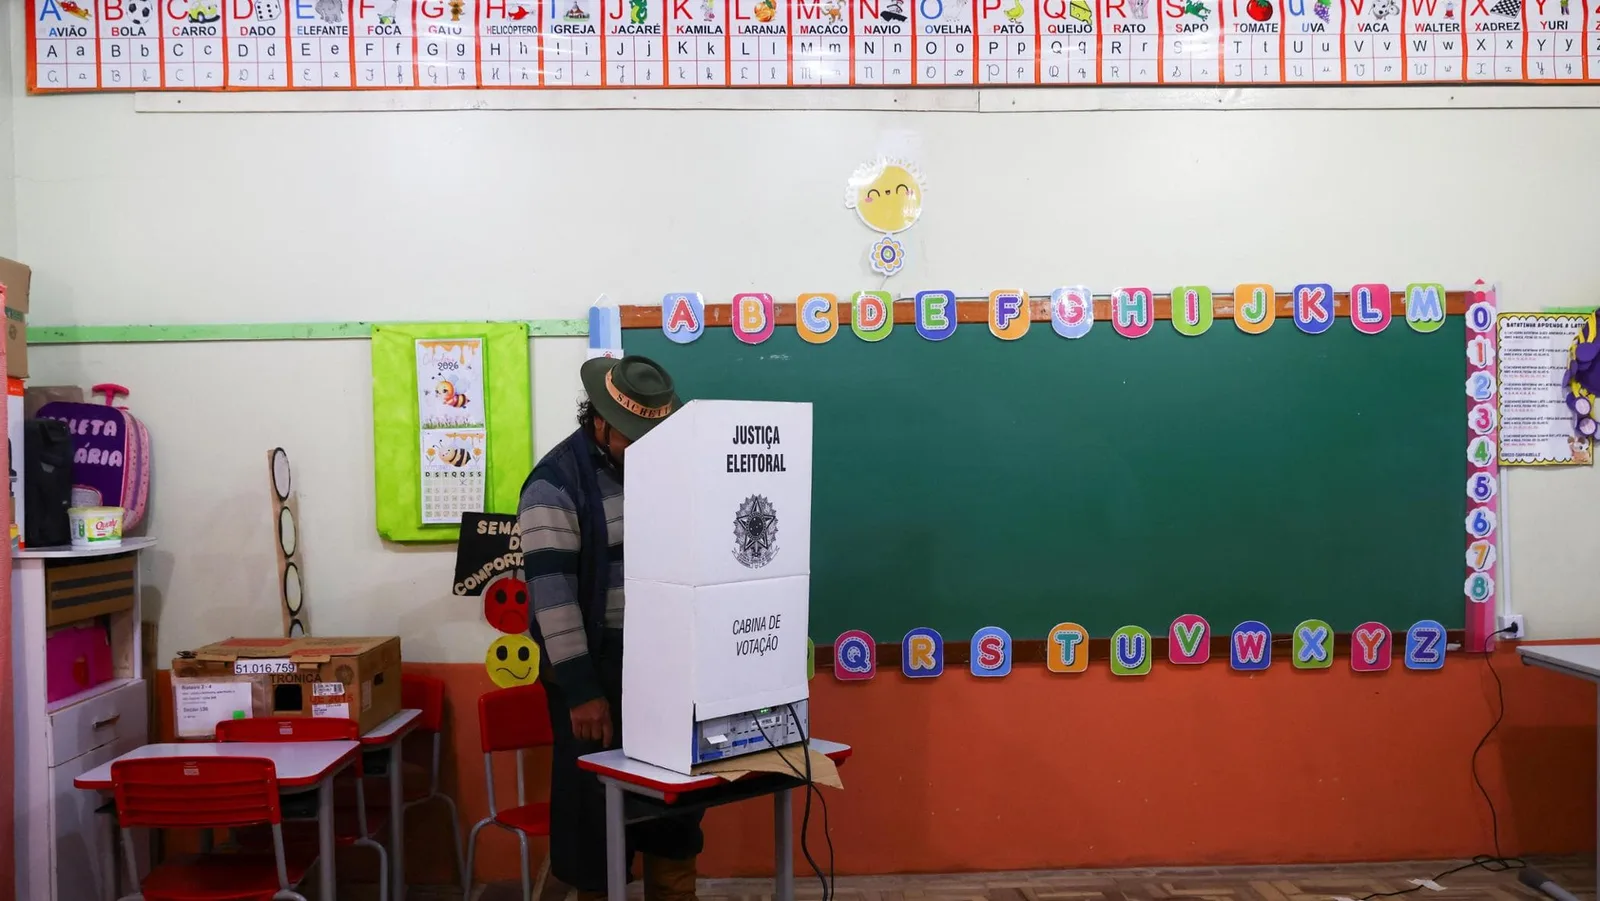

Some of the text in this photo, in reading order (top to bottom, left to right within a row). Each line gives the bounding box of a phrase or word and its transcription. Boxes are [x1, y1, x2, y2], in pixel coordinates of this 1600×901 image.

[40, 0, 62, 21] A
[105, 0, 123, 20] B
[167, 0, 190, 21] C
[234, 0, 255, 19] D
[296, 0, 314, 19] E
[360, 0, 374, 18] F
[421, 1, 444, 18] G
[487, 0, 506, 18] H
[610, 0, 623, 19] J
[674, 0, 692, 19] K
[798, 0, 820, 19] M
[860, 0, 878, 19] N
[920, 0, 943, 19] O
[983, 0, 1001, 19] P
[1044, 0, 1066, 19] Q
[1106, 0, 1126, 18] R
[1166, 0, 1185, 18] S
[49, 25, 87, 36] AVIÃO
[112, 26, 146, 36] BOLA
[172, 26, 216, 36] CARRO
[240, 26, 276, 36] DADO
[298, 26, 348, 35] ELEFANTE
[368, 25, 401, 35] FOCA
[487, 24, 538, 34] HELICÓPTERO
[551, 25, 595, 34] IGREJA
[612, 23, 660, 34] JACARÉ
[677, 25, 723, 34] KAMILA
[739, 25, 786, 35] LARANJA
[800, 25, 848, 34] MACACO
[864, 25, 900, 34] NAVIO
[925, 25, 971, 33] OVELHA
[994, 24, 1024, 33] PATO
[1048, 23, 1092, 35] QUEIJO
[1114, 24, 1145, 33] RATO
[1176, 24, 1208, 32] SAPO
[1234, 23, 1278, 32] TOMATE
[1302, 23, 1324, 32] UVA
[1358, 23, 1389, 32] VACA
[1415, 23, 1459, 33] WALTER
[1475, 22, 1520, 31] XADREZ
[1541, 21, 1568, 30] YURI
[47, 45, 84, 57] A a
[112, 44, 149, 57] B b
[238, 44, 275, 57] D d
[302, 43, 339, 56] E e
[366, 43, 373, 56] F
[427, 43, 464, 56] G g
[491, 42, 527, 55] H h
[616, 43, 624, 55] J
[679, 41, 715, 54] K k
[742, 43, 749, 55] L
[801, 42, 840, 54] M m
[865, 42, 901, 54] N n
[989, 42, 1025, 55] P p
[1051, 41, 1086, 54] Q q
[1112, 41, 1121, 54] R
[1234, 41, 1242, 53] T
[1537, 39, 1573, 51] Y y
[668, 286, 1443, 332] A B C D E F G H I J K L M
[1474, 307, 1489, 328] 0
[1476, 342, 1485, 366] 1
[438, 360, 458, 371] 2026
[1475, 374, 1490, 397] 2
[1476, 408, 1491, 431] 3
[732, 425, 780, 449] JUSTIÇA
[1475, 441, 1490, 464] 4
[726, 454, 786, 474] ELEITORAL
[1474, 476, 1490, 499] 5
[96, 518, 117, 530] Qualy
[1473, 512, 1490, 534] 6
[509, 536, 522, 550] D
[1472, 545, 1490, 567] 7
[454, 552, 524, 596] COMPORT
[1472, 578, 1488, 598] 8
[732, 614, 781, 635] CABINA DE
[736, 634, 778, 656] VOTAÇÃO
[838, 622, 1441, 672] Q R S T U V W X Y Z
[236, 662, 295, 674] 51.016.759
